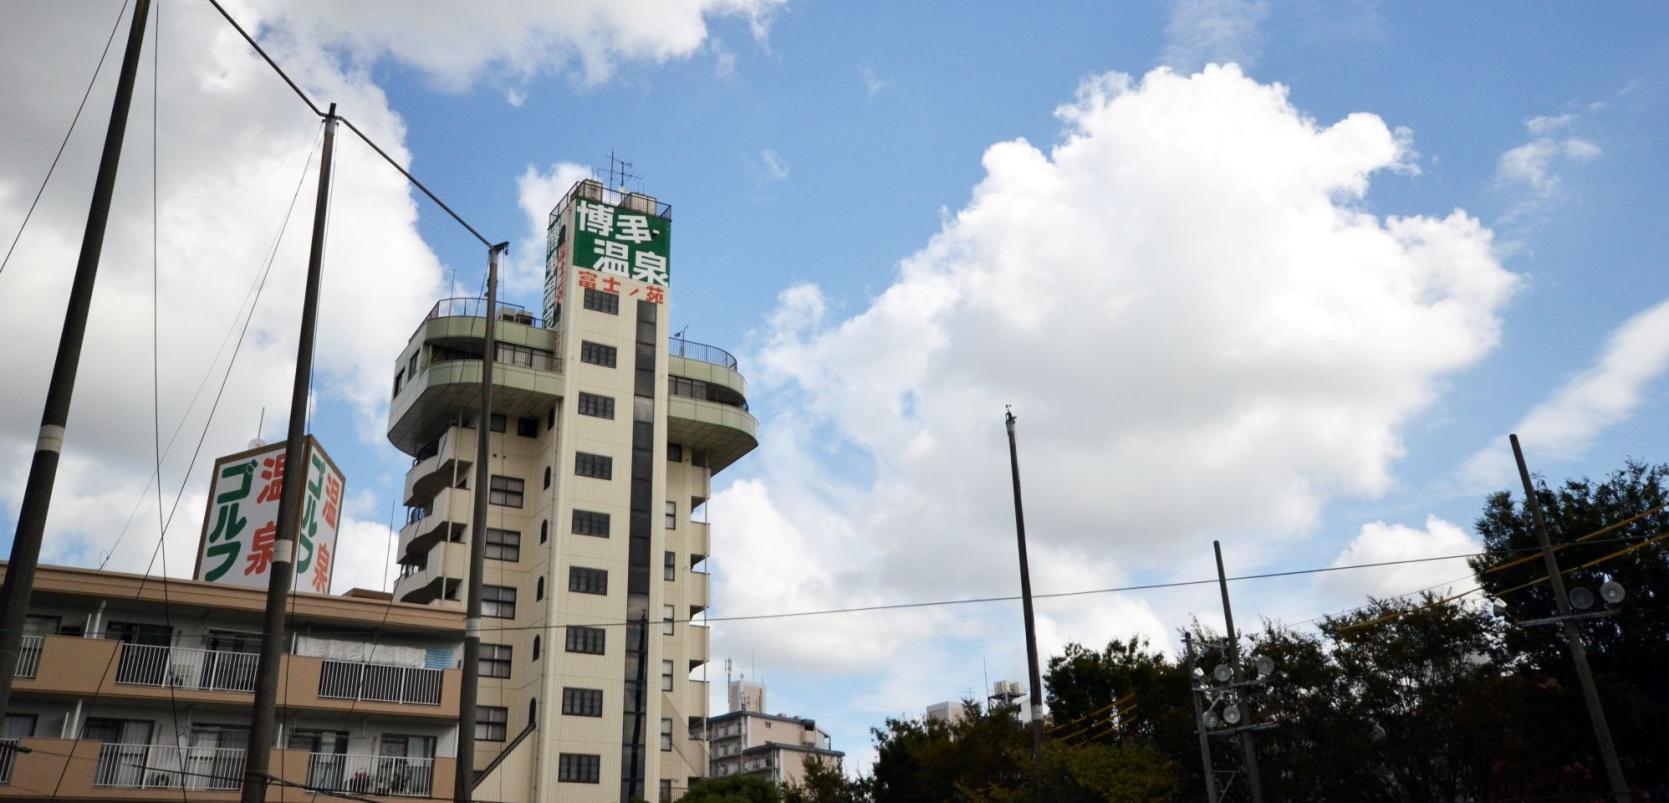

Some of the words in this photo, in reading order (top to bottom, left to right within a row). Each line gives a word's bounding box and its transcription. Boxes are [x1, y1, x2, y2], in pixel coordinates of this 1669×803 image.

[578, 271, 664, 304] 富士ノ苑
[592, 238, 669, 287] 温泉
[204, 459, 258, 582] ゴルフ
[298, 453, 325, 574] ゴルフ
[312, 473, 340, 594] 温泉
